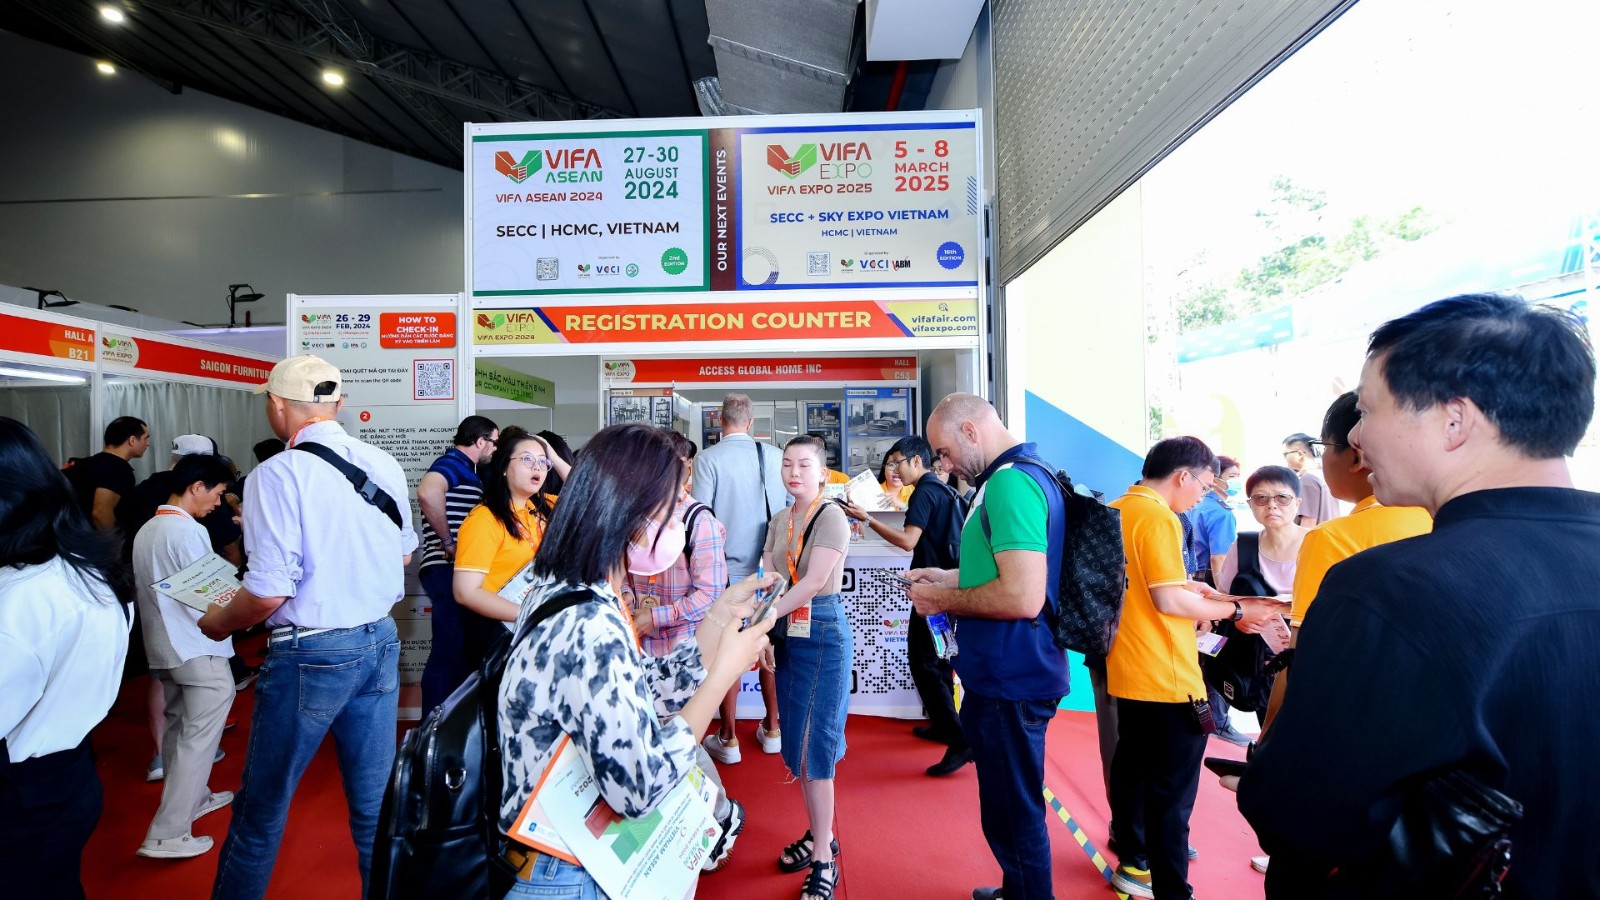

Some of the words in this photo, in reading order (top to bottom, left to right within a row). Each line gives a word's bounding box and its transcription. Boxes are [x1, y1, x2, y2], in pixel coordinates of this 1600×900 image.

[624, 146, 679, 163] 27-30
[820, 142, 872, 160] VIFA
[895, 141, 907, 158] 5
[934, 140, 949, 158] 8
[545, 148, 602, 169] VIFA
[625, 167, 678, 179] AUGUST
[820, 163, 872, 179] EXPO
[895, 162, 949, 173] MARCH
[545, 170, 602, 183] ASEAN
[717, 150, 727, 203] EVENTS
[895, 176, 949, 192] 2025
[625, 180, 679, 200] 2024
[767, 185, 795, 195] VIFA
[800, 185, 832, 194] EXPO
[837, 184, 872, 194] 2025
[496, 194, 522, 203] VIFA
[525, 192, 566, 202] ASEAN
[570, 192, 602, 201] 2024
[717, 205, 727, 239] NEXT
[770, 212, 804, 223] SECC
[819, 211, 843, 222] SKY
[848, 211, 883, 221] EXPO
[888, 210, 949, 220] VIETNAM
[496, 225, 537, 237] SECC
[551, 224, 602, 237] HCMC,
[606, 222, 679, 234] VIETNAM
[857, 228, 897, 236] VIETNAM
[717, 242, 727, 272] OUR
[860, 260, 889, 269] VCCI
[596, 265, 620, 273] VCCI
[506, 313, 534, 323] VIFA
[565, 312, 744, 330] REGISTRATION
[751, 311, 872, 329] COUNTER
[912, 315, 976, 323] vifafair.com
[506, 323, 535, 332] EXPO
[65, 330, 85, 342] HALL
[87, 333, 93, 343] A
[68, 348, 89, 361] B21
[200, 359, 230, 374] SAIGON
[233, 365, 271, 380] FURNITUR
[699, 365, 735, 375] ACCESS
[738, 365, 772, 375] GLOBAL
[776, 364, 802, 374] HOME
[806, 364, 821, 373] INC
[574, 775, 593, 798] 2024
[658, 825, 680, 855] VIETNAM
[643, 854, 661, 878] ASEAN
